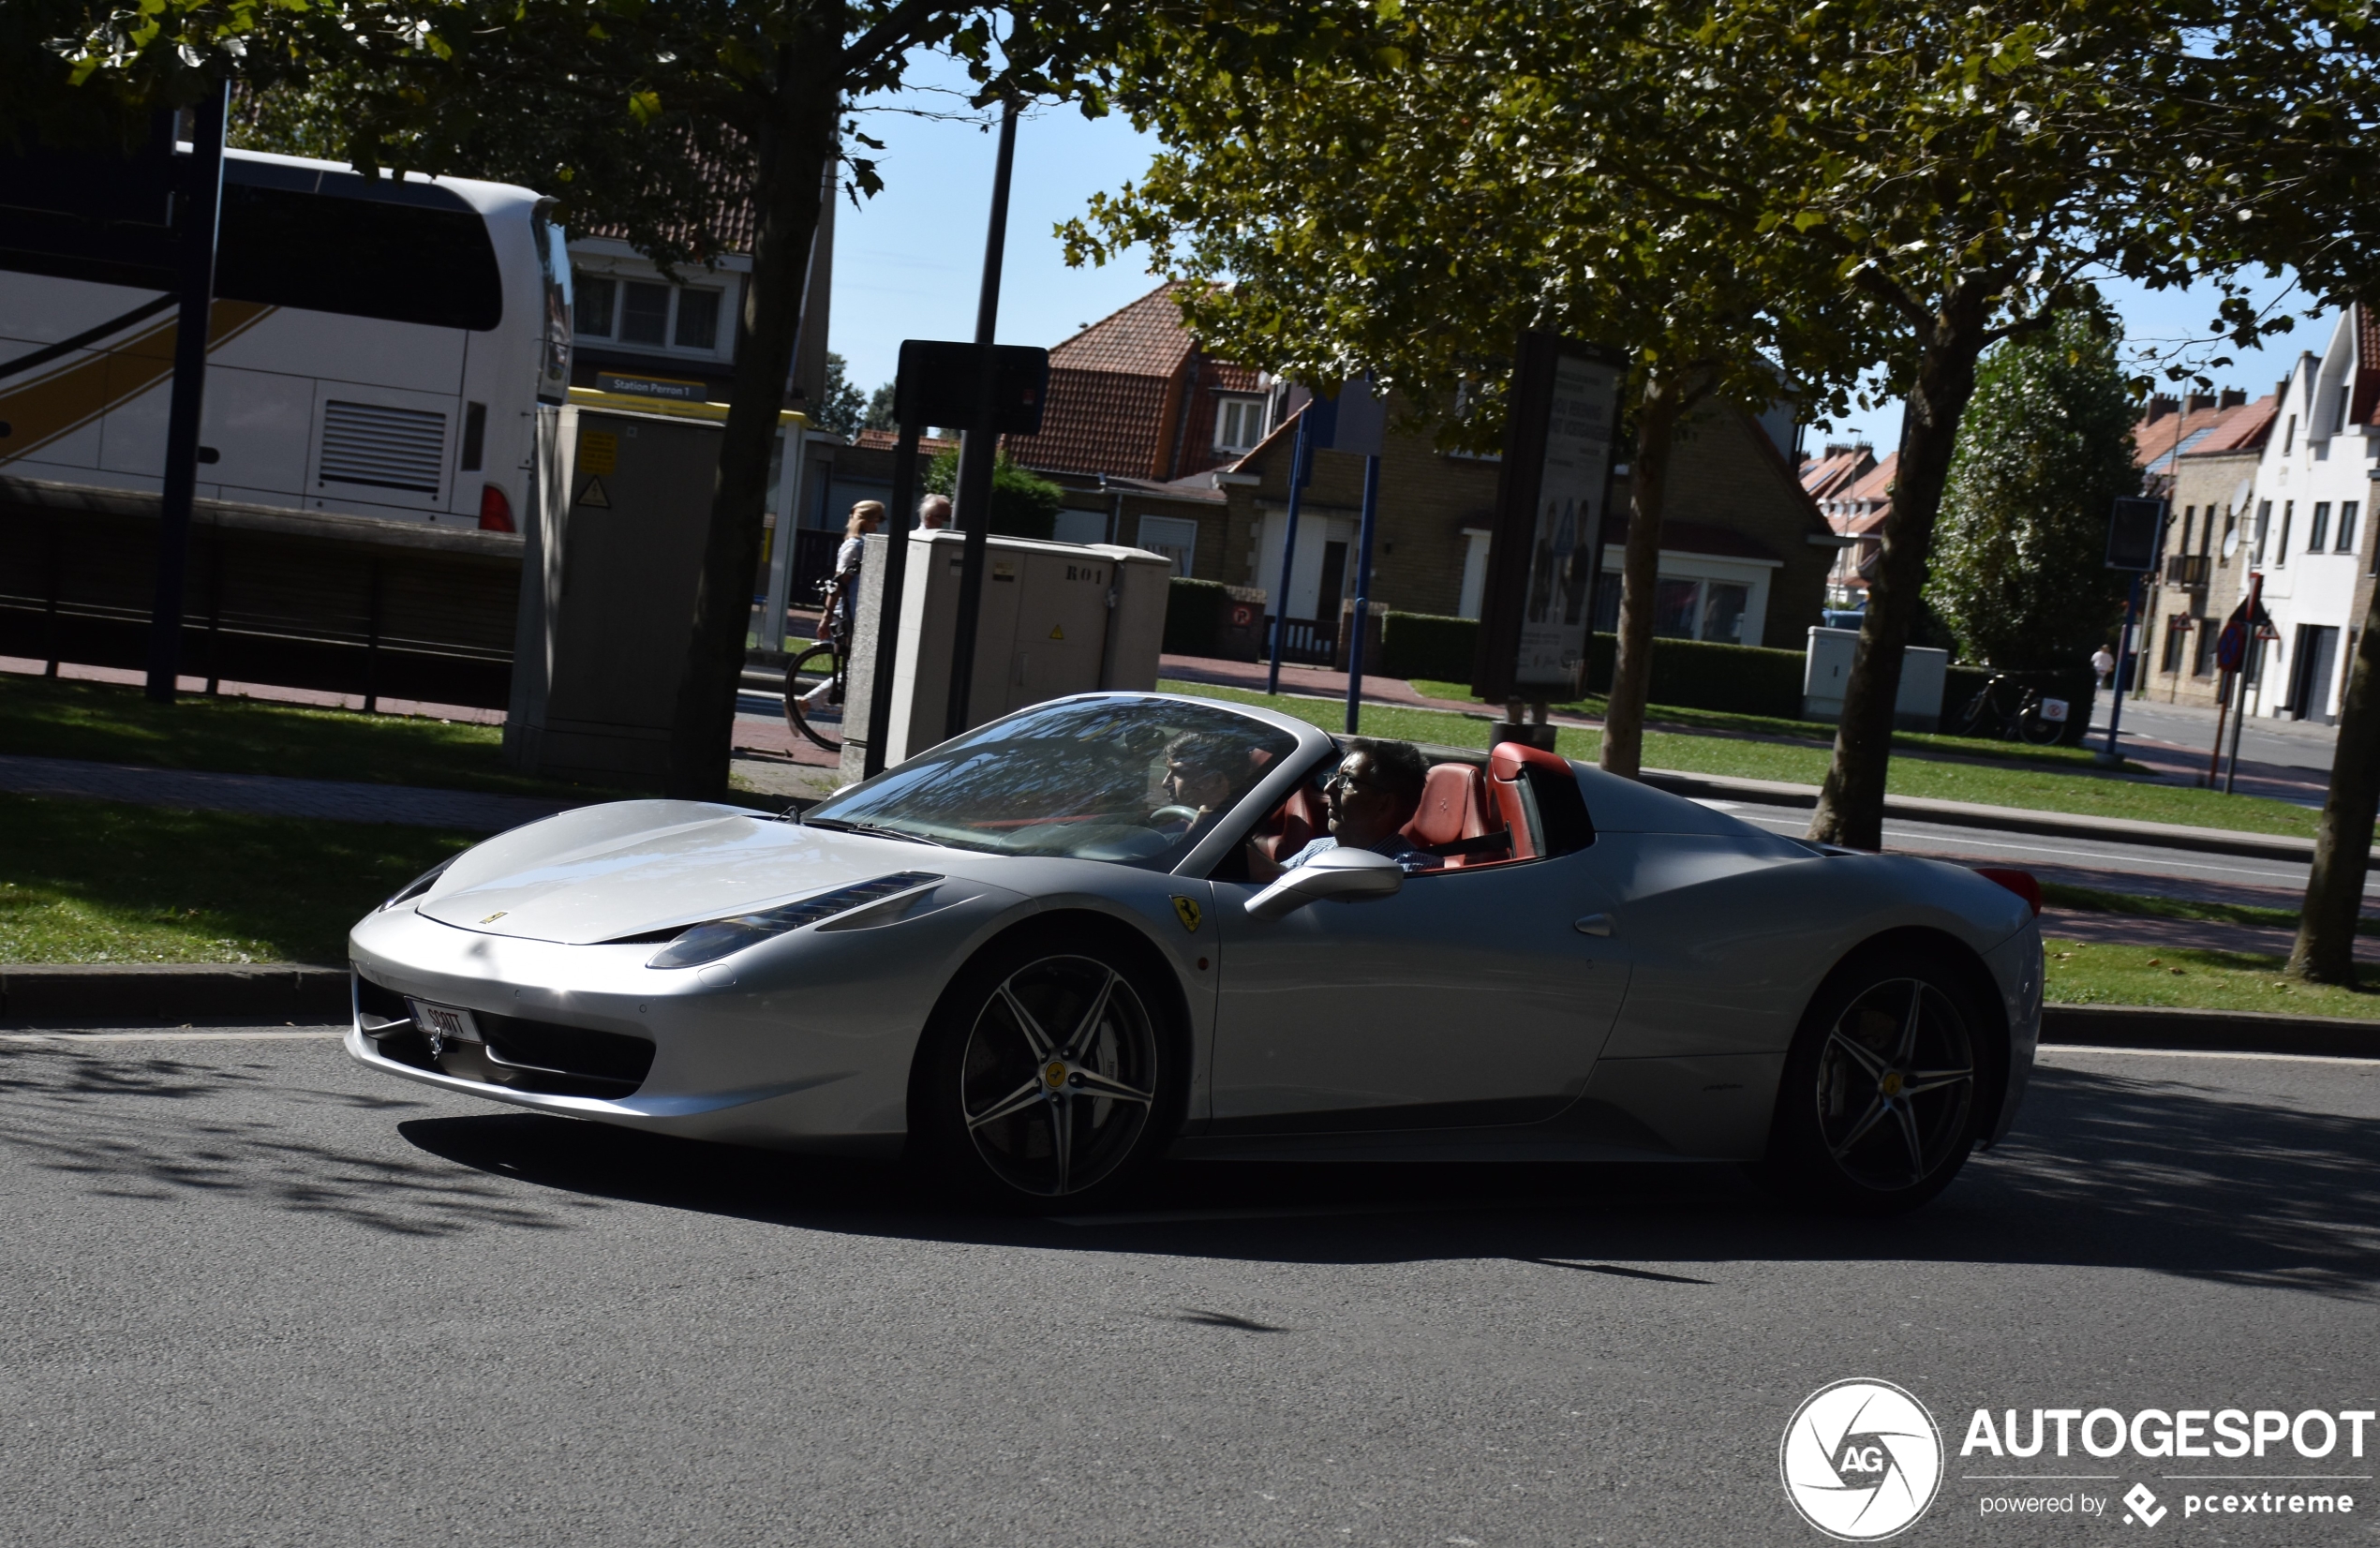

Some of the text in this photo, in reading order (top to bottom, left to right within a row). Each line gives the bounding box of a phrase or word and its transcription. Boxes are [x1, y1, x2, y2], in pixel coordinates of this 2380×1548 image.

[614, 380, 690, 395] Station Perron 1
[427, 1008, 464, 1034] SCOTT
